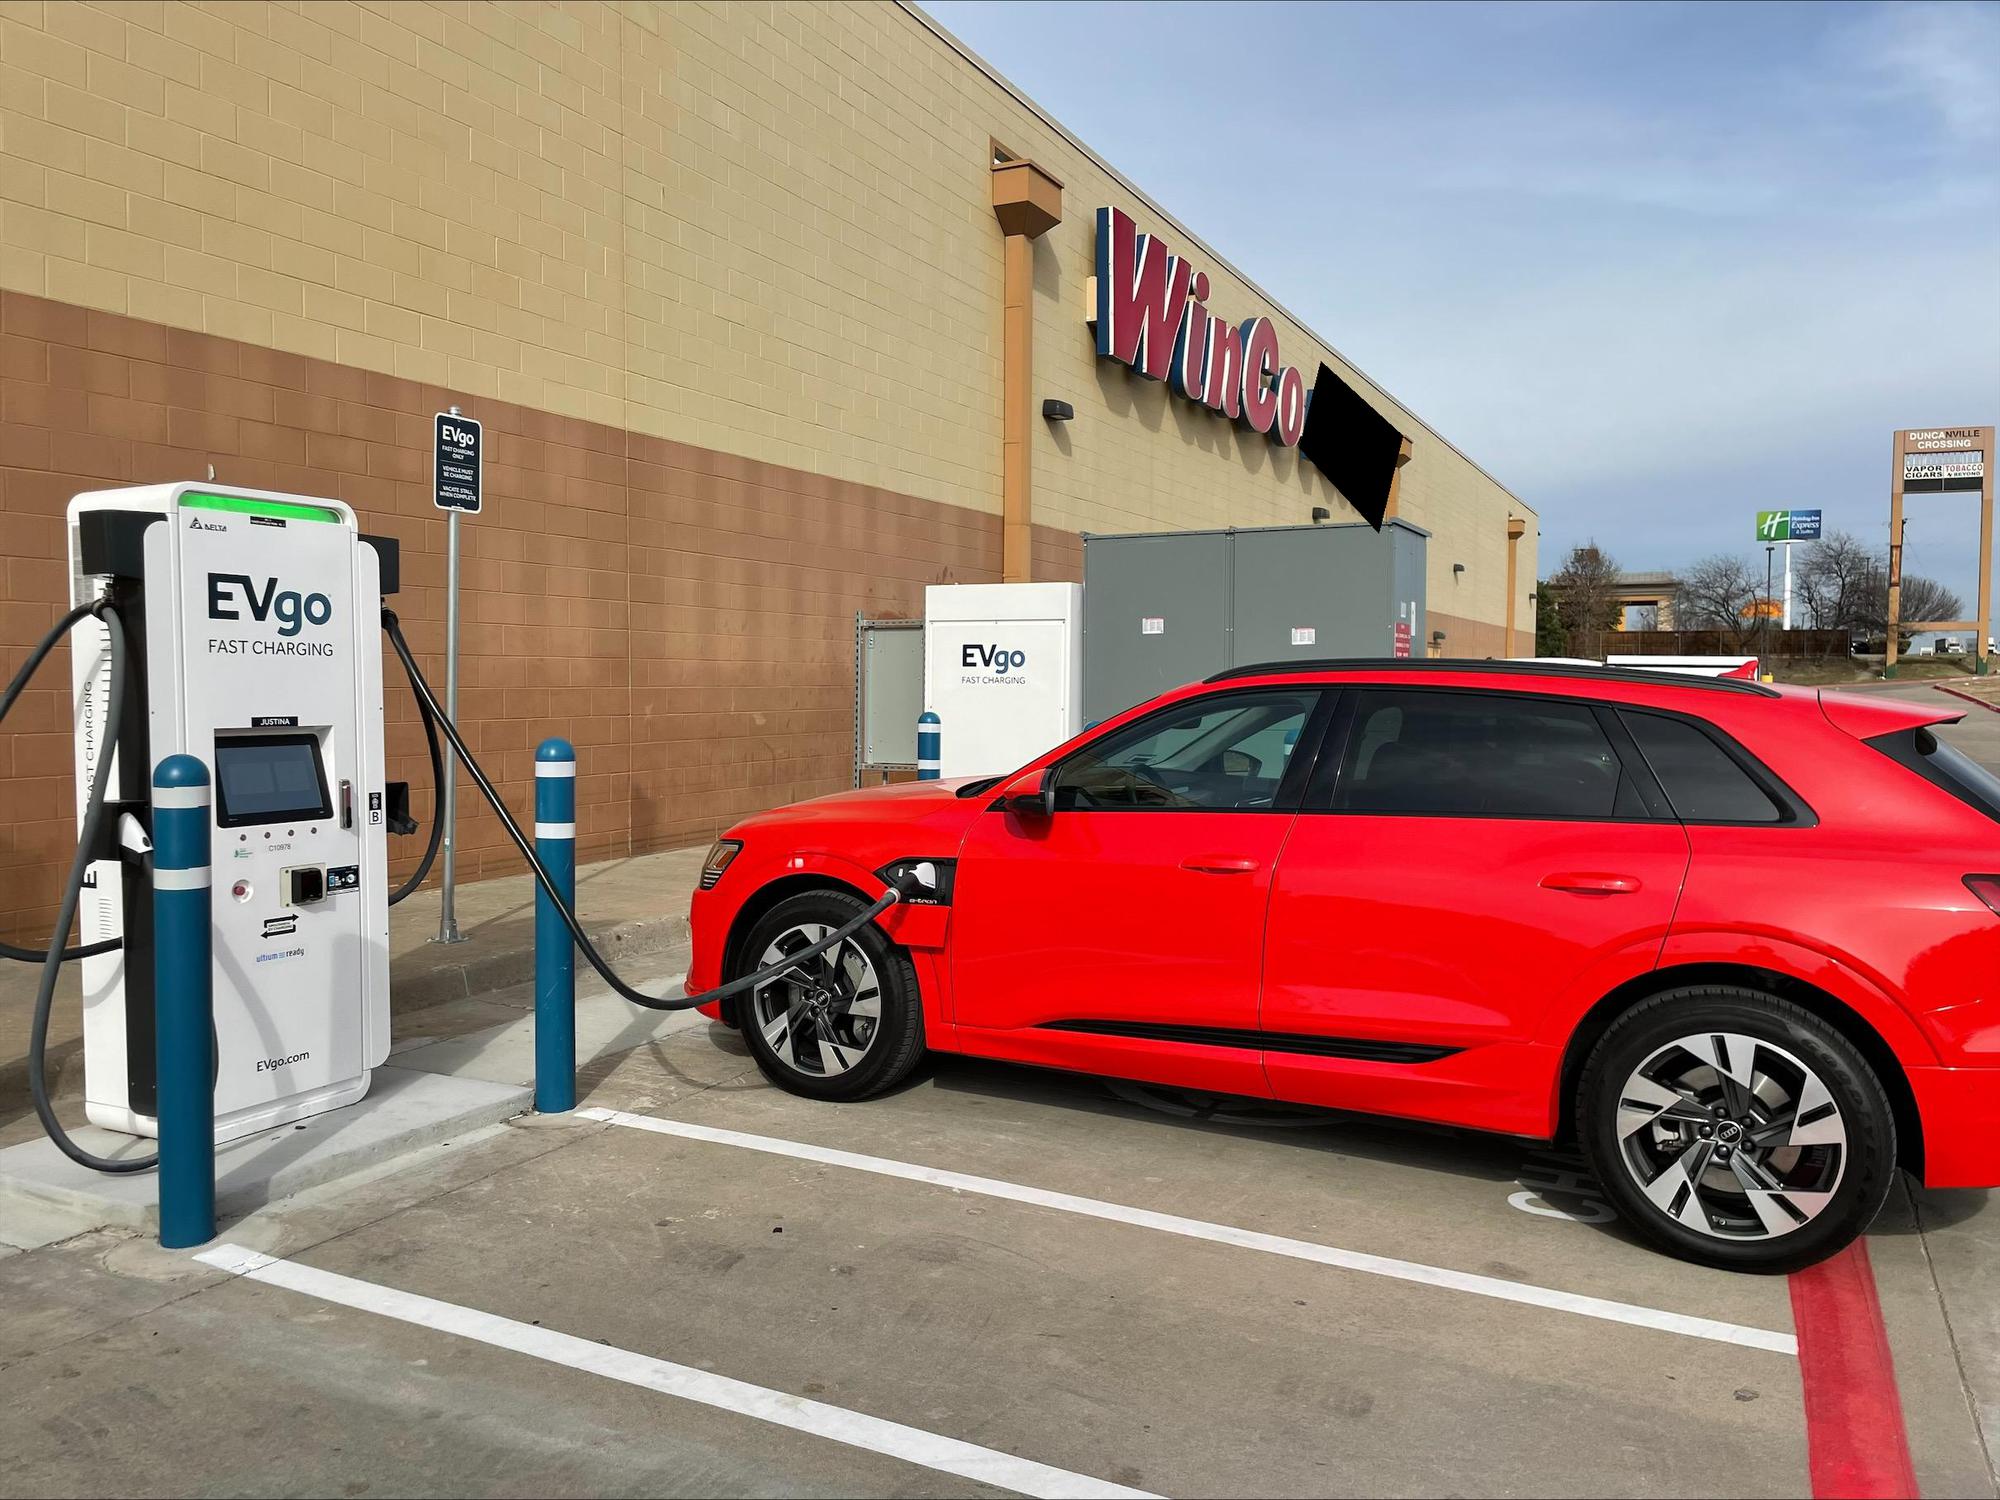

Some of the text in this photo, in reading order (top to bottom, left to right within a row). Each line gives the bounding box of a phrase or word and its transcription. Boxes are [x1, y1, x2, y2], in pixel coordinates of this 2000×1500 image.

[1097, 206, 1305, 448] WinCo
[442, 425, 475, 448] EVgo
[1909, 430, 1980, 440] DUNCANVILLE
[1917, 439, 1972, 449] CROSSING
[452, 447, 475, 457] CHARGING
[1945, 464, 1983, 472] TOBACCO
[449, 472, 473, 481] CHARGING
[442, 485, 460, 493] VACATE
[439, 490, 477, 502] WHEN COMPLETE
[204, 523, 228, 533] DELTA
[207, 571, 332, 637] EVgo
[208, 638, 334, 658] FAST CHARGING
[962, 643, 1026, 675] EVgo
[961, 676, 1026, 685] FAST CHARGING
[84, 680, 95, 760] CHARGING
[259, 717, 291, 727] JUSTINA
[372, 811, 380, 820] B
[268, 843, 292, 852] C10978
[286, 947, 305, 957] ready
[256, 1049, 310, 1073] EVgo.com
